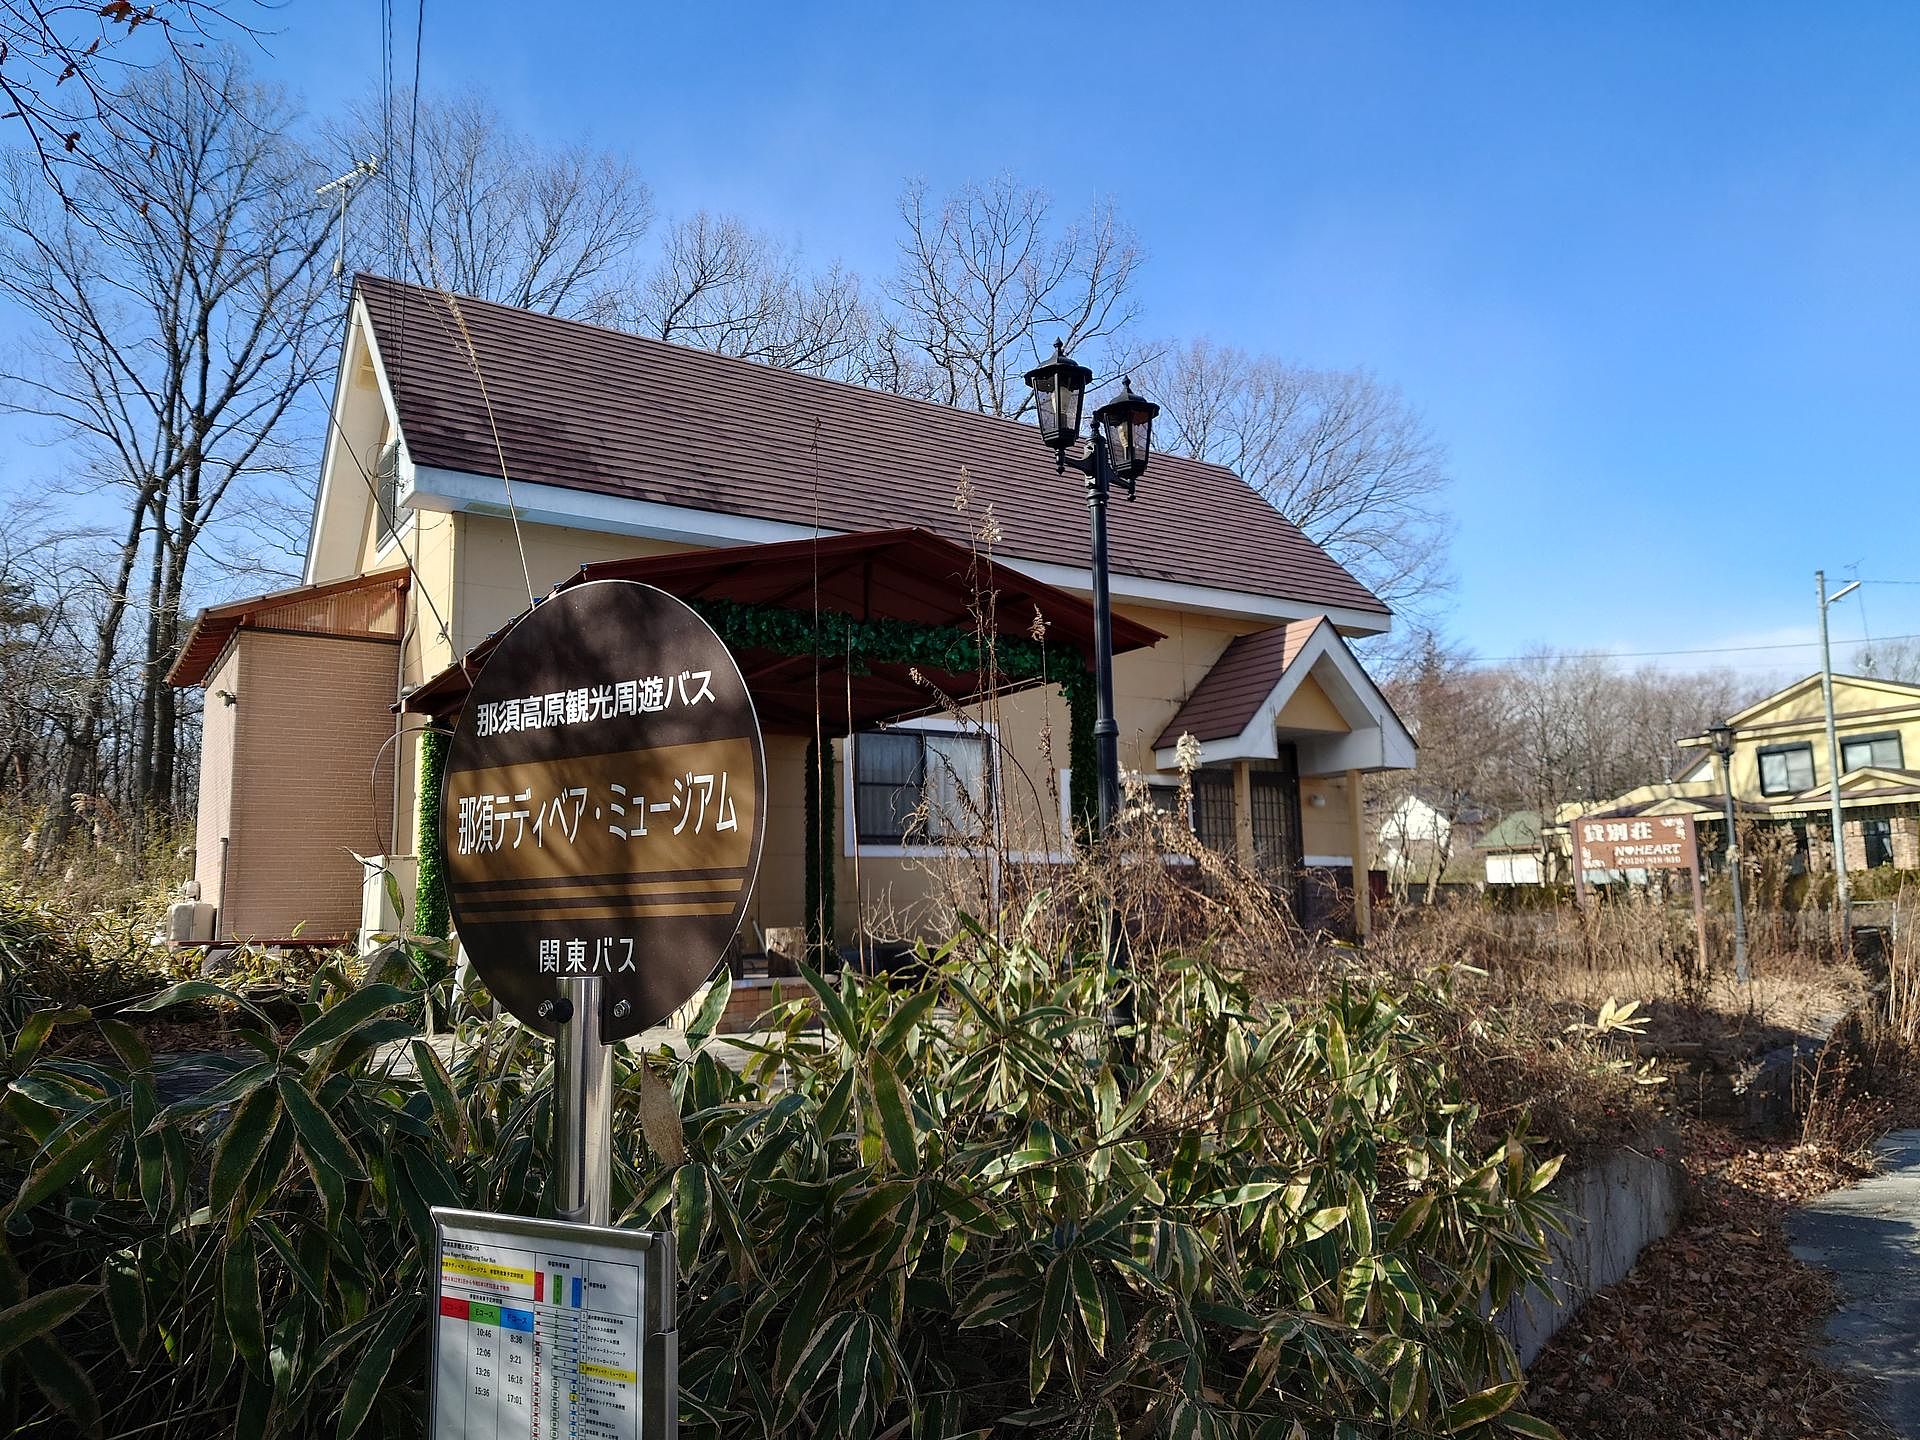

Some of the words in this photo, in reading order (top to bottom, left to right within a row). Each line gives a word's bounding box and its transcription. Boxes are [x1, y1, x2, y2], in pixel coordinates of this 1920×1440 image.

[476, 670, 717, 737] 那須高原観光周遊バス
[456, 771, 738, 855] 那須テディベア・ミュージアム
[539, 937, 637, 974] 関東バス
[475, 1308, 495, 1318] Eコース
[476, 1327, 492, 1338] 10:46
[509, 1354, 522, 1365] 9:21
[507, 1394, 522, 1405] 17:01
